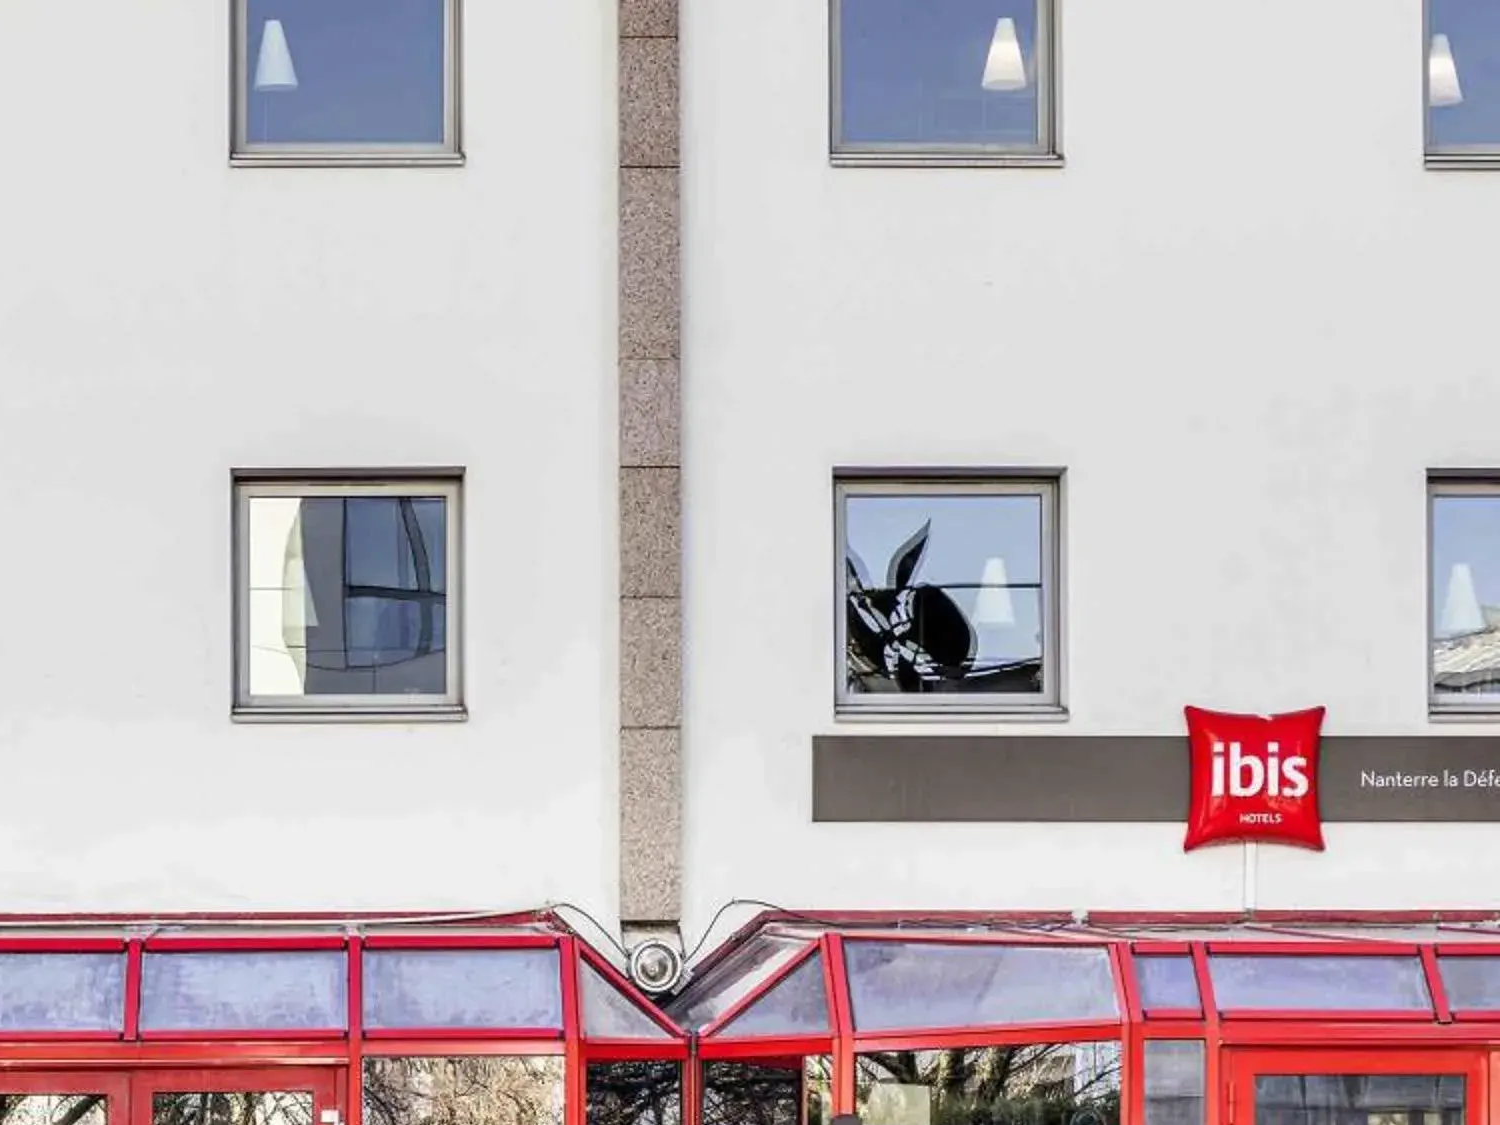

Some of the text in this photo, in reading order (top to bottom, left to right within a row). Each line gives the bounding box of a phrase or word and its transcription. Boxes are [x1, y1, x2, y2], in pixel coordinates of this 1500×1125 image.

[1211, 741, 1309, 797] ibis
[1360, 769, 1439, 787] Nanterre
[1443, 769, 1459, 787] la
[1239, 813, 1283, 824] HOTELS
